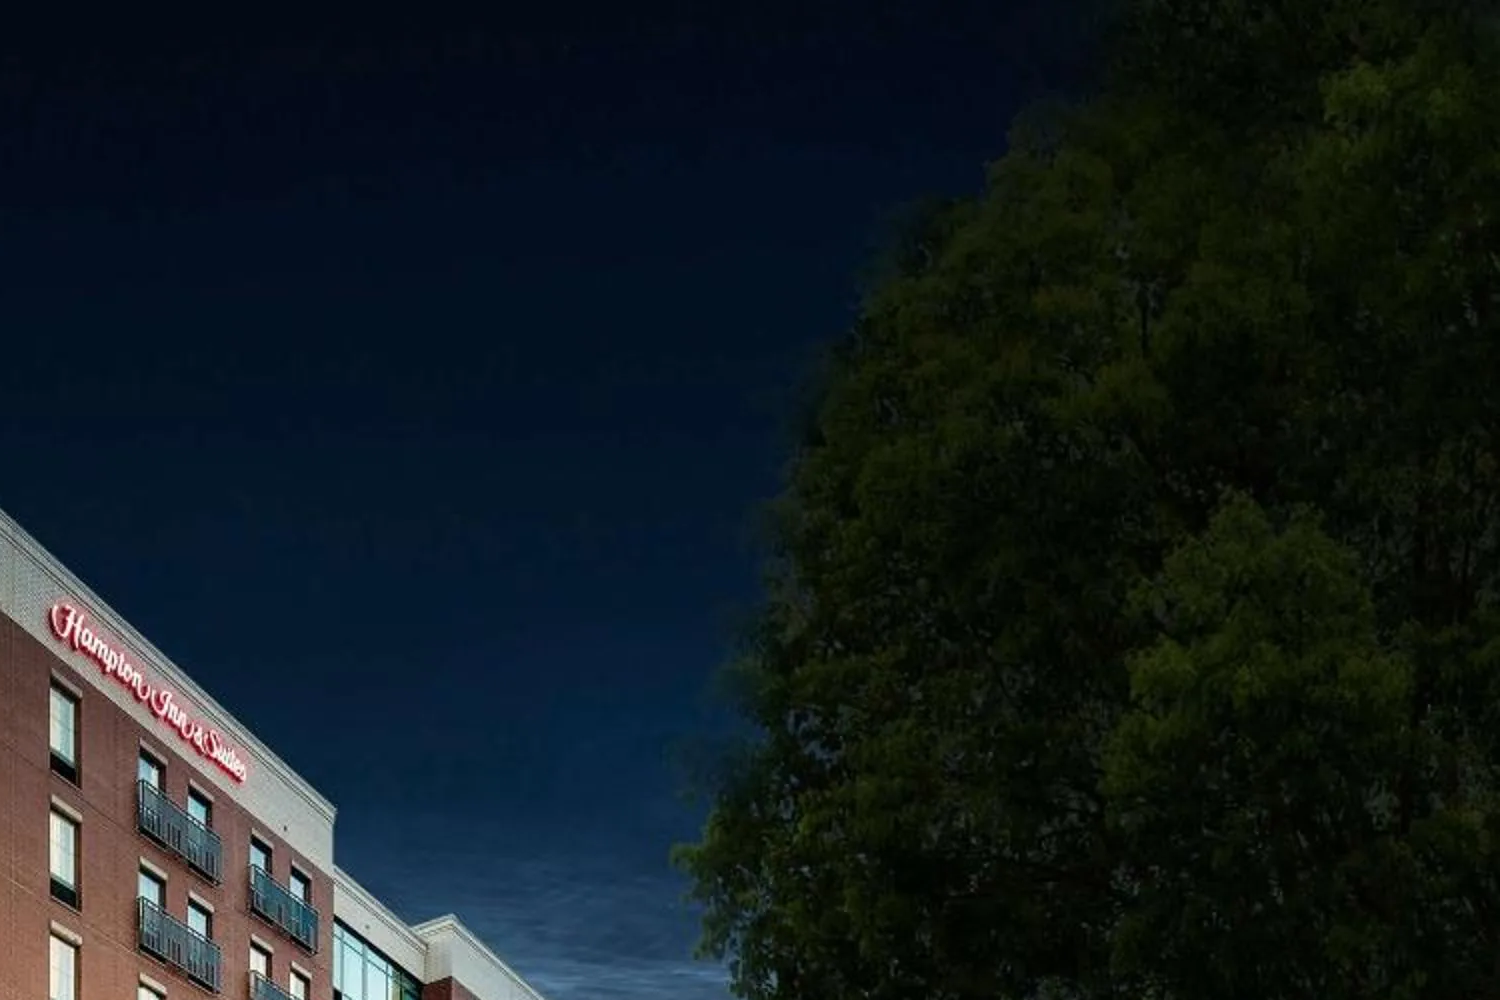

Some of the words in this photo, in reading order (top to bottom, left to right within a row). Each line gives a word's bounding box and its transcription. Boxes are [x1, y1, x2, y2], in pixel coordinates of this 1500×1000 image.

[50, 604, 151, 701] Hampton
[150, 690, 195, 740] Inn
[203, 729, 247, 782] Suites
